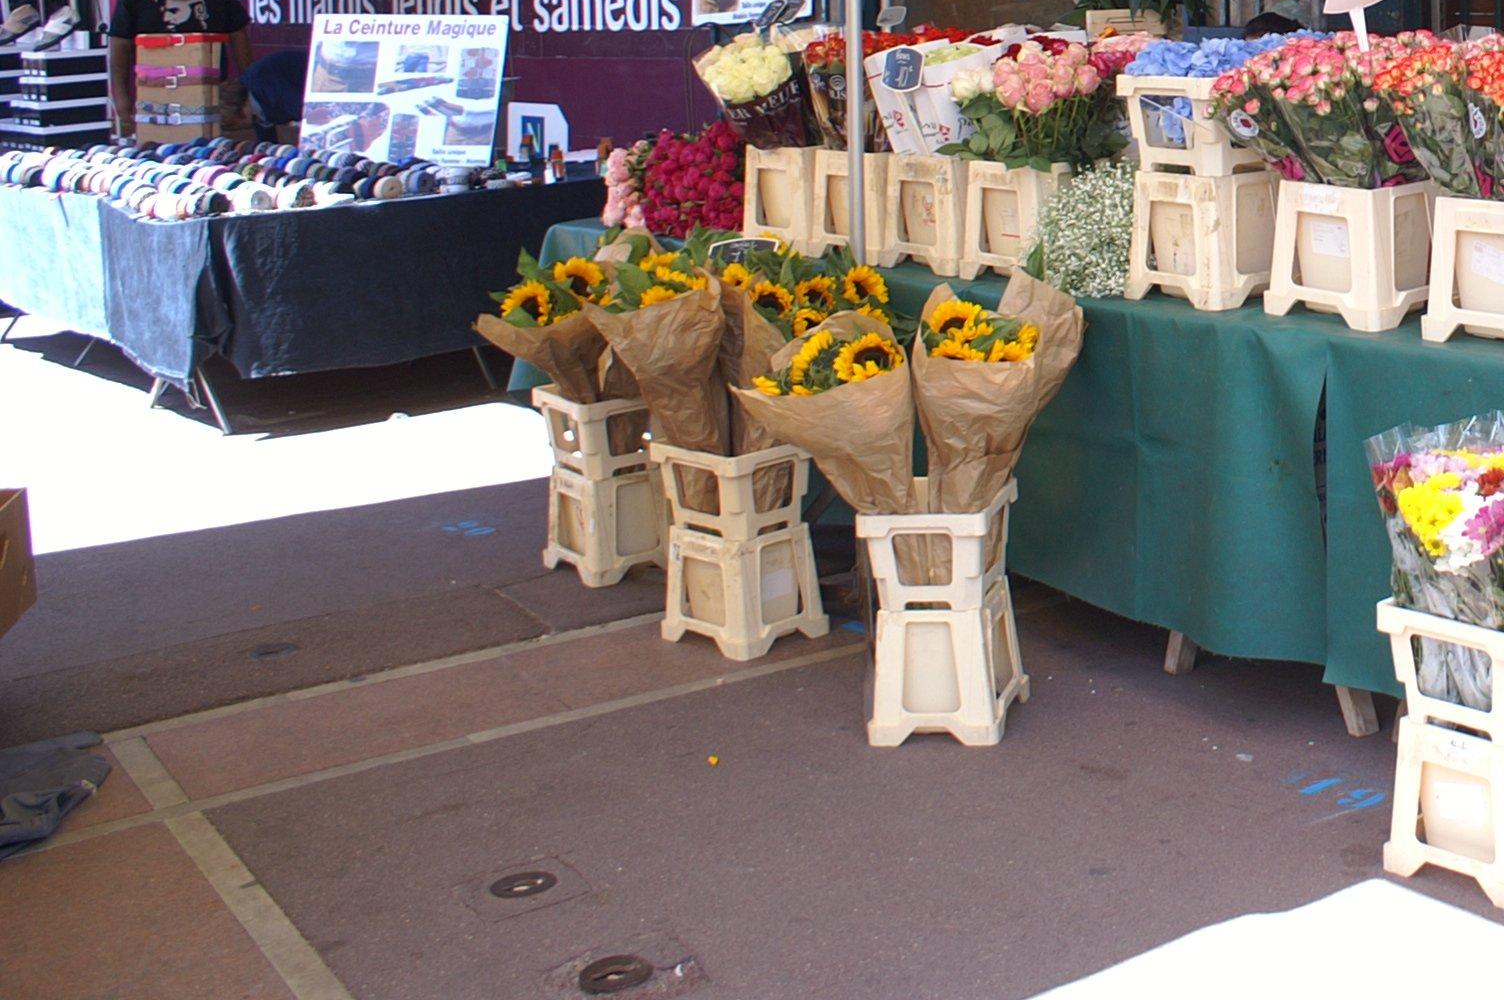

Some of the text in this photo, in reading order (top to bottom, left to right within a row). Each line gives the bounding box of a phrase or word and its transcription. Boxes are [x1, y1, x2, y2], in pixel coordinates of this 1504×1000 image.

[323, 19, 497, 39] La Ceinture Magique
